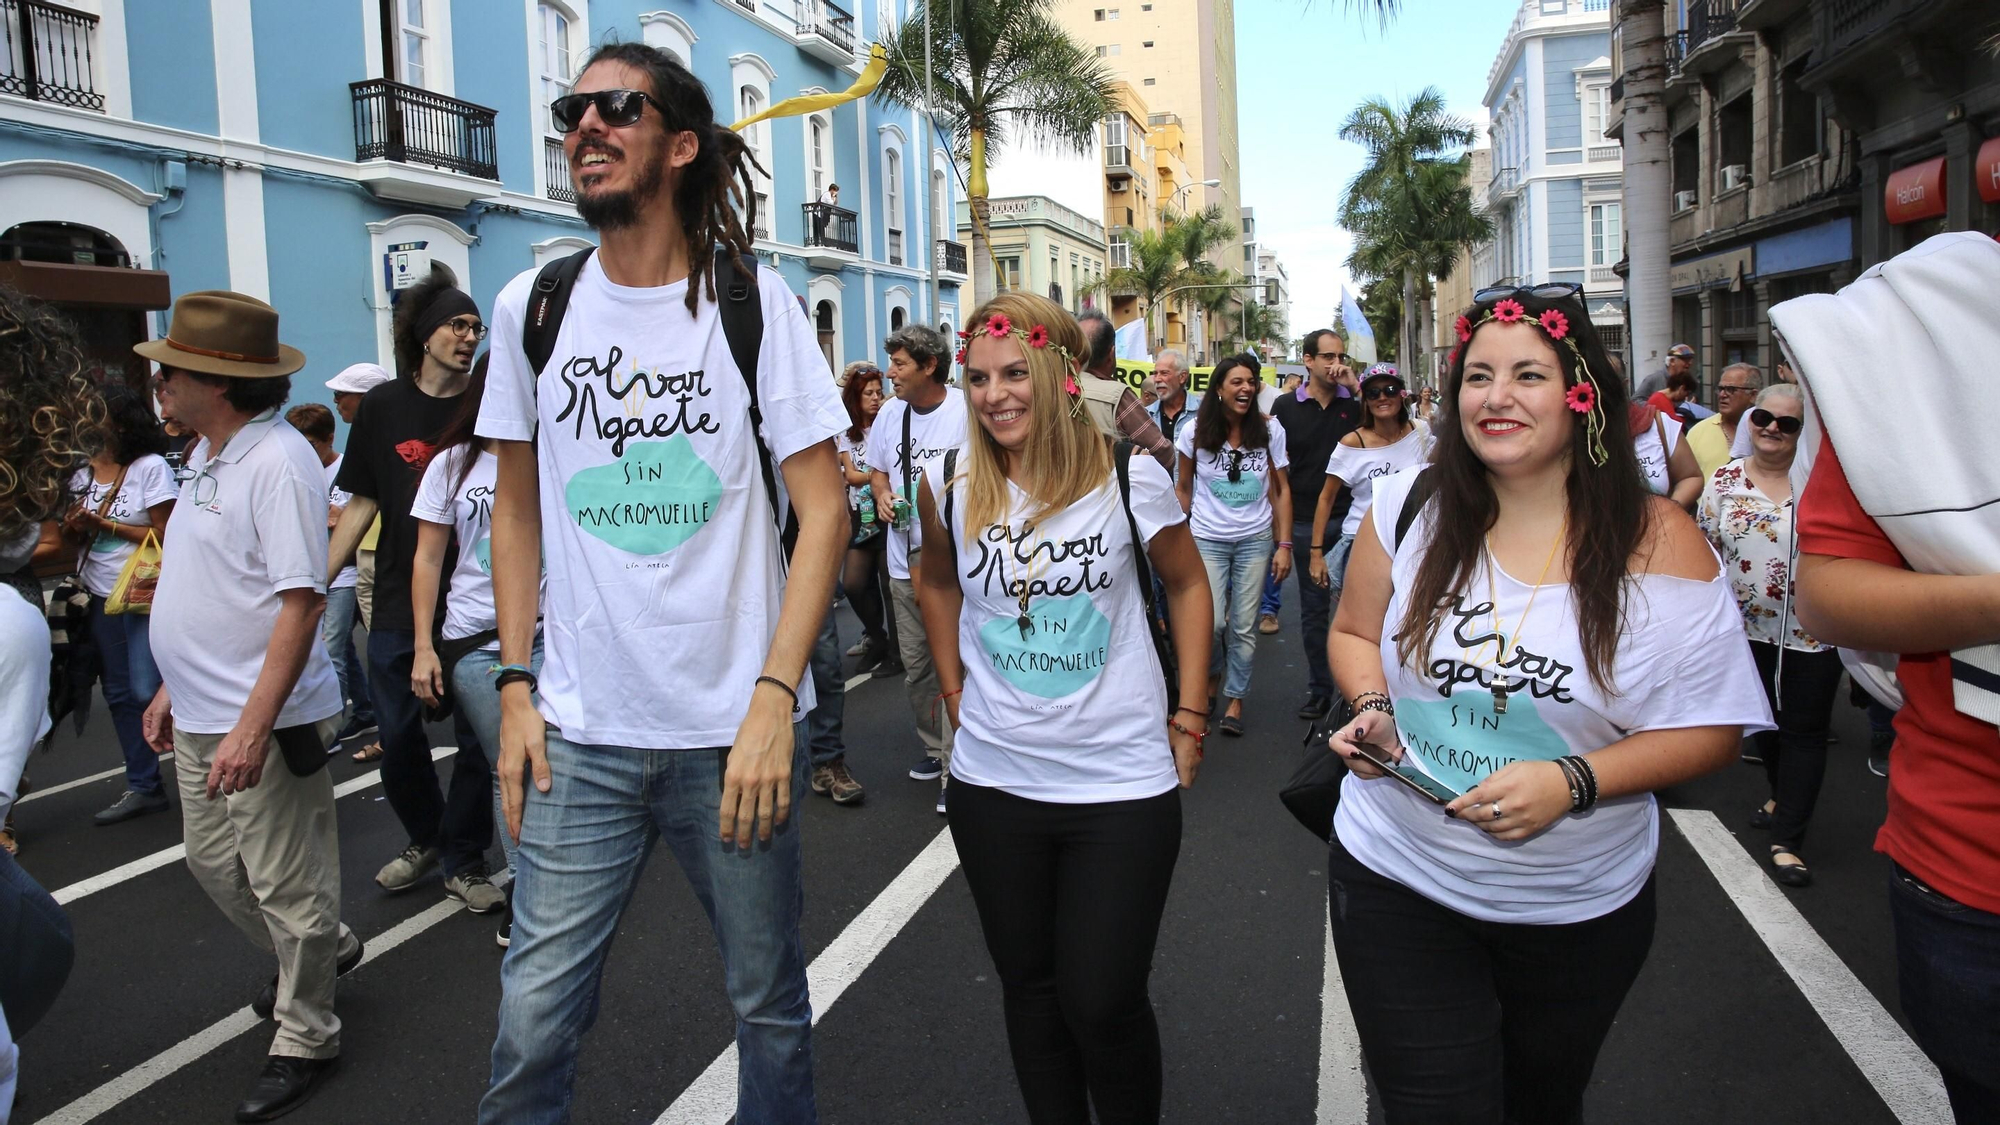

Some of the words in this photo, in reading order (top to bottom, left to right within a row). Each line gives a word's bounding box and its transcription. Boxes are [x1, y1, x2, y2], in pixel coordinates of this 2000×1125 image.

[537, 296, 548, 326] EASTPAK
[556, 346, 711, 423] Salvar
[576, 394, 720, 457] Agaete
[578, 501, 710, 527] MACROMUELLE
[992, 647, 1105, 673] MACROMUELLE
